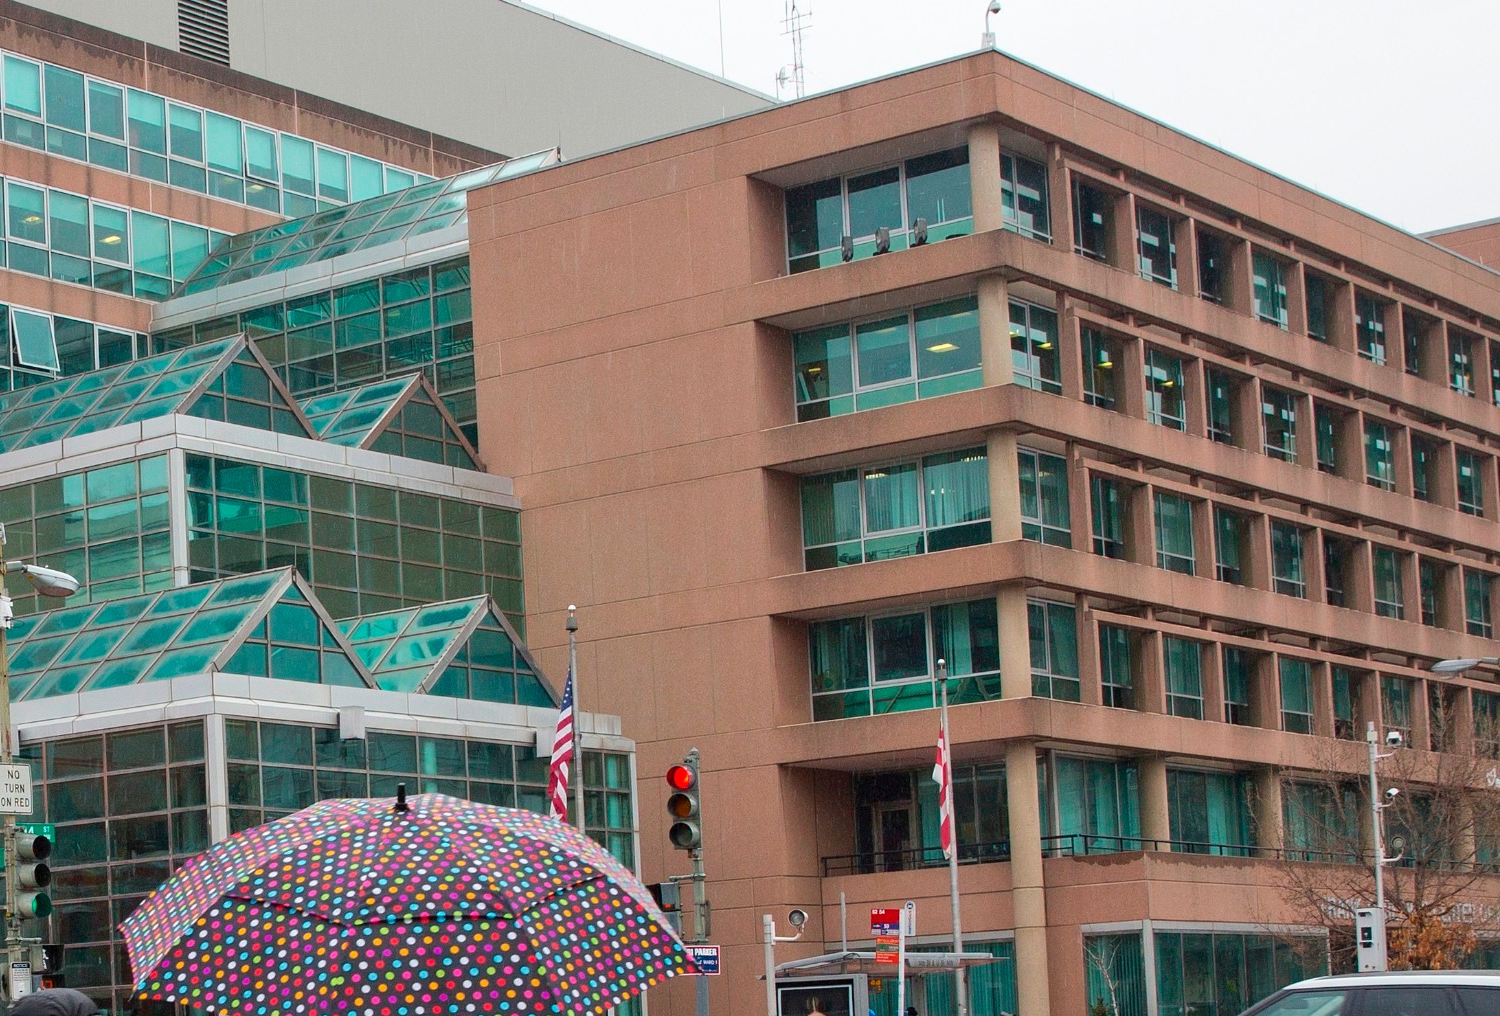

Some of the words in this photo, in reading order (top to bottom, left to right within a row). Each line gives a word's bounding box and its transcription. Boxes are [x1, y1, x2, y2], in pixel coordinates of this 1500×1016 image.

[7, 769, 20, 780] NO
[4, 783, 25, 793] TURN
[0, 797, 12, 807] ON
[14, 797, 30, 808] RED
